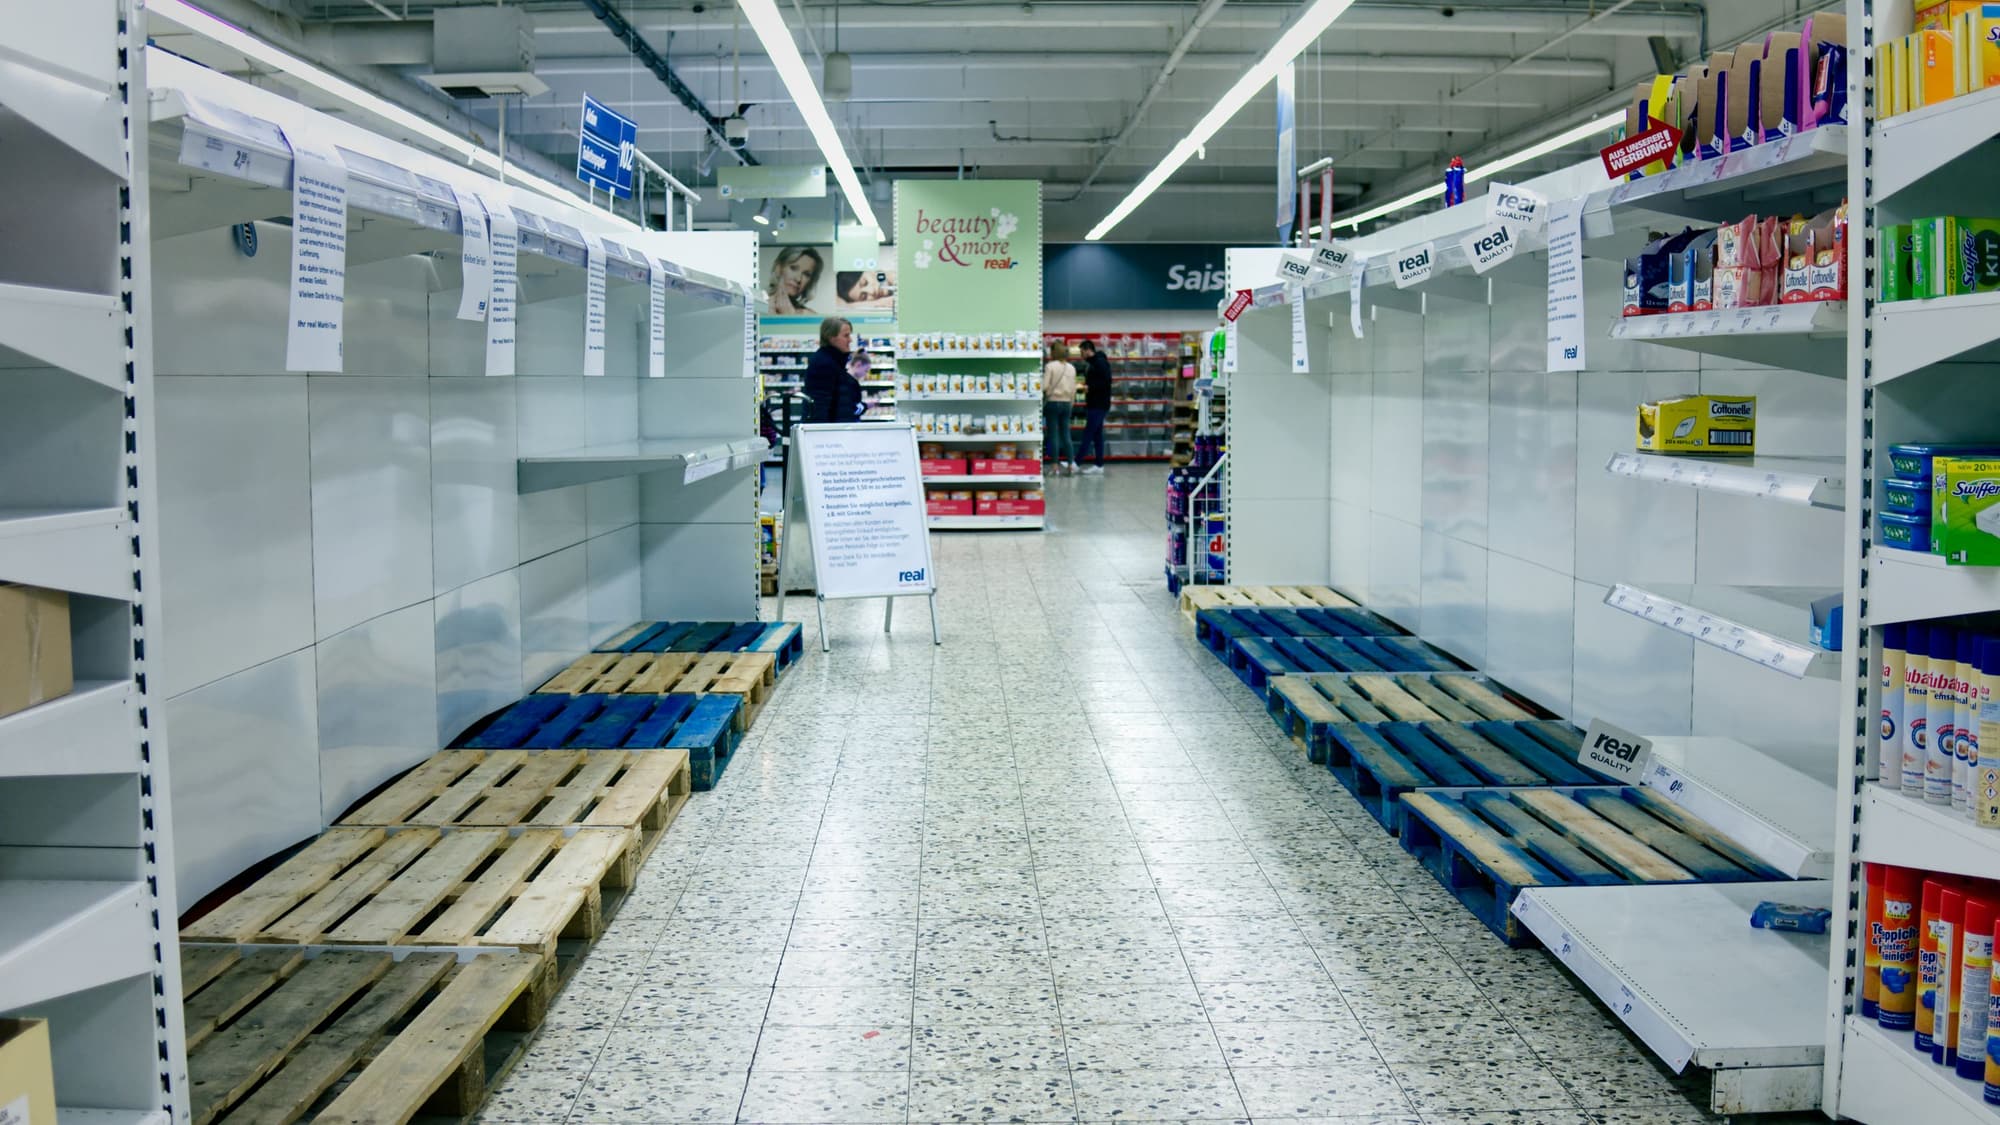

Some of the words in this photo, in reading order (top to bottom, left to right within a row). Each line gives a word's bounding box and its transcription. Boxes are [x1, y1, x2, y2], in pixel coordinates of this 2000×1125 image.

[620, 140, 634, 172] 102
[1608, 147, 1626, 162] AUS
[1626, 132, 1664, 152] UNSERER
[1610, 129, 1673, 171] WERBUNG!
[916, 209, 996, 240] beauty
[1496, 209, 1534, 222] QUALITY
[938, 234, 972, 266] &
[962, 241, 1010, 255] more
[1474, 225, 1510, 256] real
[1318, 248, 1348, 264] real
[1398, 249, 1430, 272] real
[1480, 243, 1514, 264] QUALITY
[1962, 228, 1979, 293] Swiffer
[1986, 238, 1998, 276] KIT
[1166, 264, 1226, 292] Sais
[1284, 260, 1310, 276] real
[1402, 266, 1432, 280] QUALITY
[1812, 270, 1836, 286] Cottonelle
[1786, 272, 1808, 288] Cottonelle
[1564, 345, 1578, 359] real
[1711, 403, 1751, 415] Cottonelle
[899, 568, 925, 582] real
[1593, 733, 1641, 763] real
[1590, 752, 1631, 774] QUALITY
[1884, 900, 1912, 914] TOP
